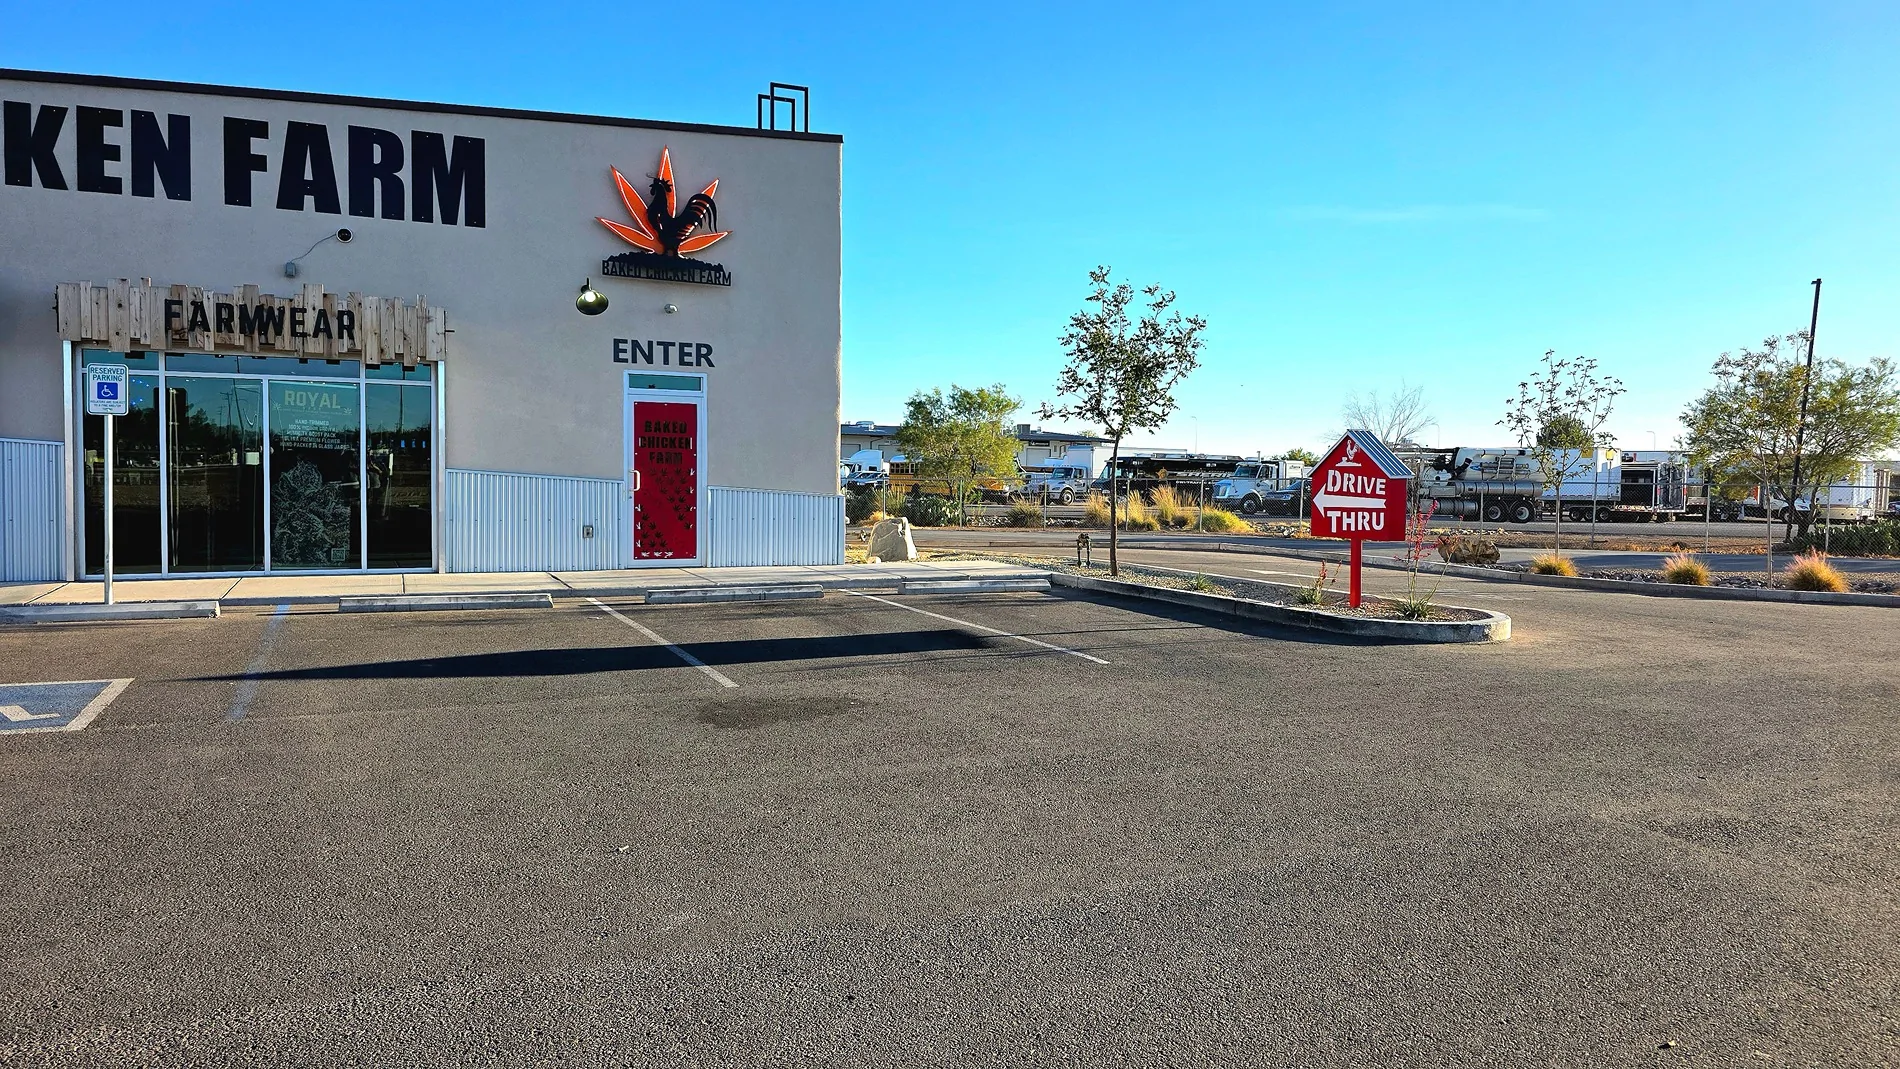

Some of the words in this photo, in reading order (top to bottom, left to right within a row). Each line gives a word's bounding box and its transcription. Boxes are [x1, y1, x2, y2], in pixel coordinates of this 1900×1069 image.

[4, 100, 192, 202] KEN
[223, 116, 486, 229] FARM
[602, 259, 645, 279] BAKED
[699, 266, 732, 287] FARM
[164, 298, 356, 341] FARMWEAR
[613, 338, 716, 368] ENTER
[90, 367, 125, 375] RESERVED
[92, 374, 123, 382] PARKING
[284, 390, 341, 409] ROYAL
[644, 419, 687, 434] BAKED
[639, 436, 692, 450] CHICKEN
[649, 451, 683, 465] FARM
[1327, 469, 1387, 496] DRIVE
[1326, 510, 1385, 533] THRU
